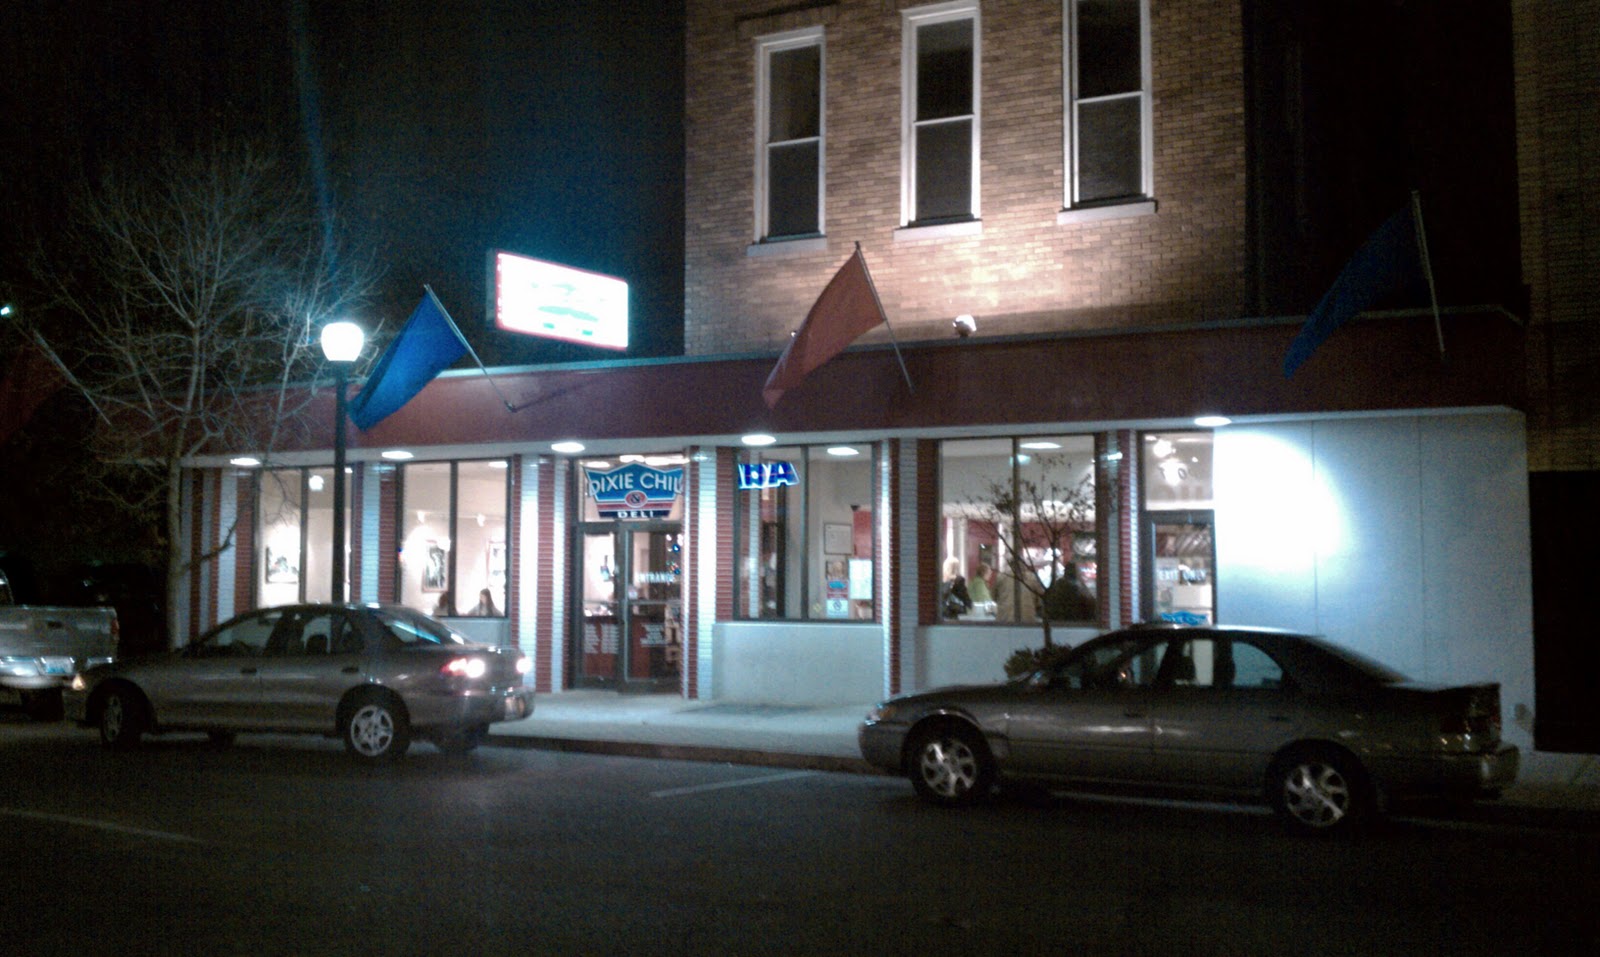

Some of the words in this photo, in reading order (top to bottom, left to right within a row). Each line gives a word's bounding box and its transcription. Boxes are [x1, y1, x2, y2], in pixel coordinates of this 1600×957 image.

[589, 473, 634, 496] DIXIE
[630, 493, 641, 504] &
[617, 510, 654, 518] DELI
